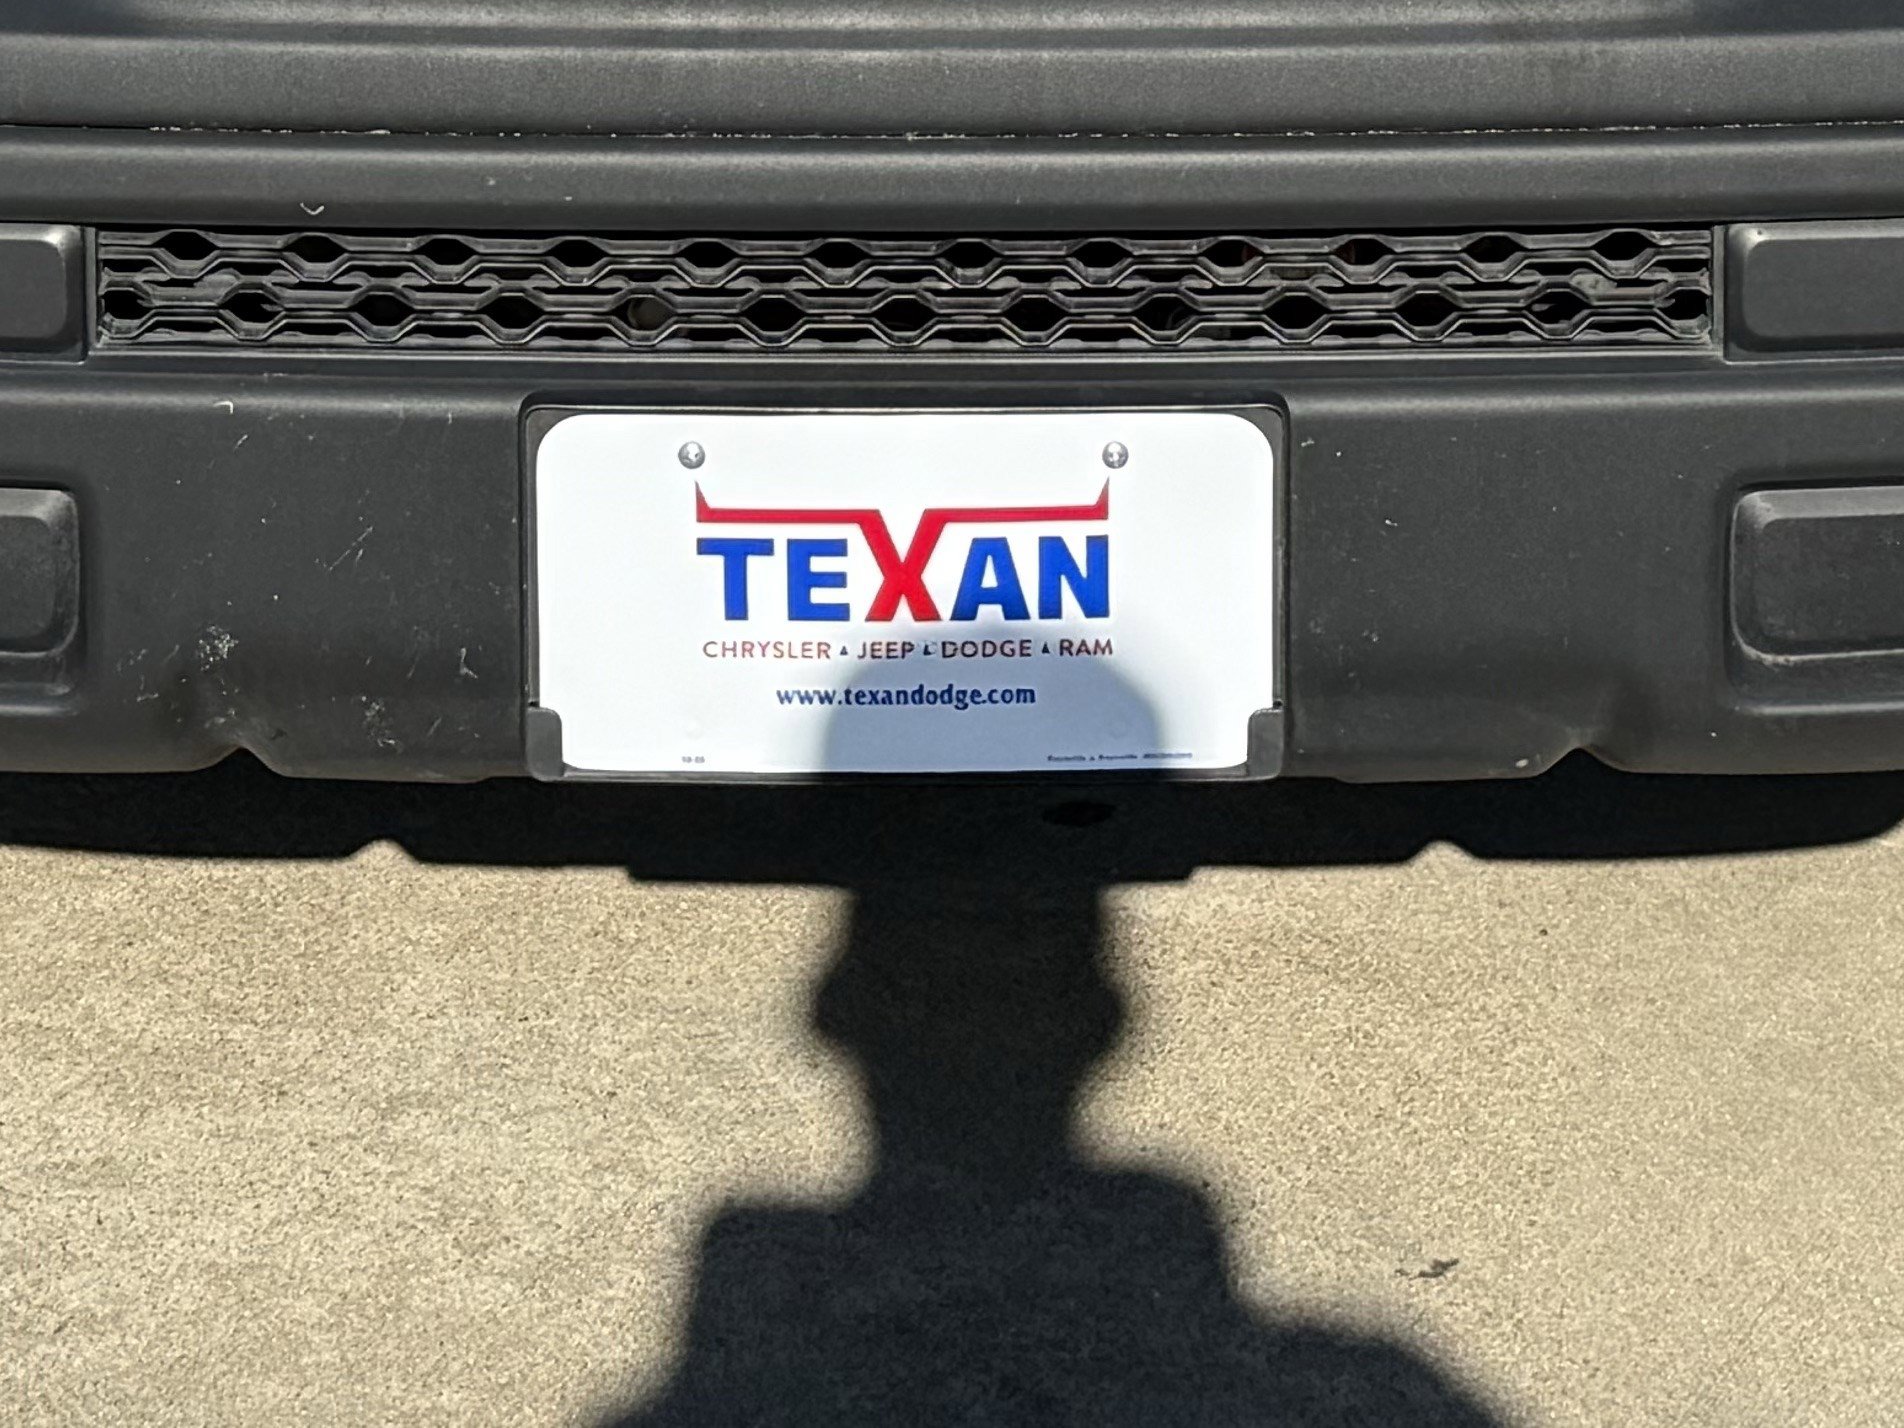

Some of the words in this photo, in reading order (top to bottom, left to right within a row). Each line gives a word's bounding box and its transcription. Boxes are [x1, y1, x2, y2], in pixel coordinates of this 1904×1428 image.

[696, 478, 1110, 622] TEXAN
[701, 640, 832, 660] CHRYSLER
[856, 639, 916, 660] JEEP
[940, 638, 1034, 659] DODGE
[1058, 637, 1115, 658] RAM
[775, 683, 1037, 712] www.texandodge.com
